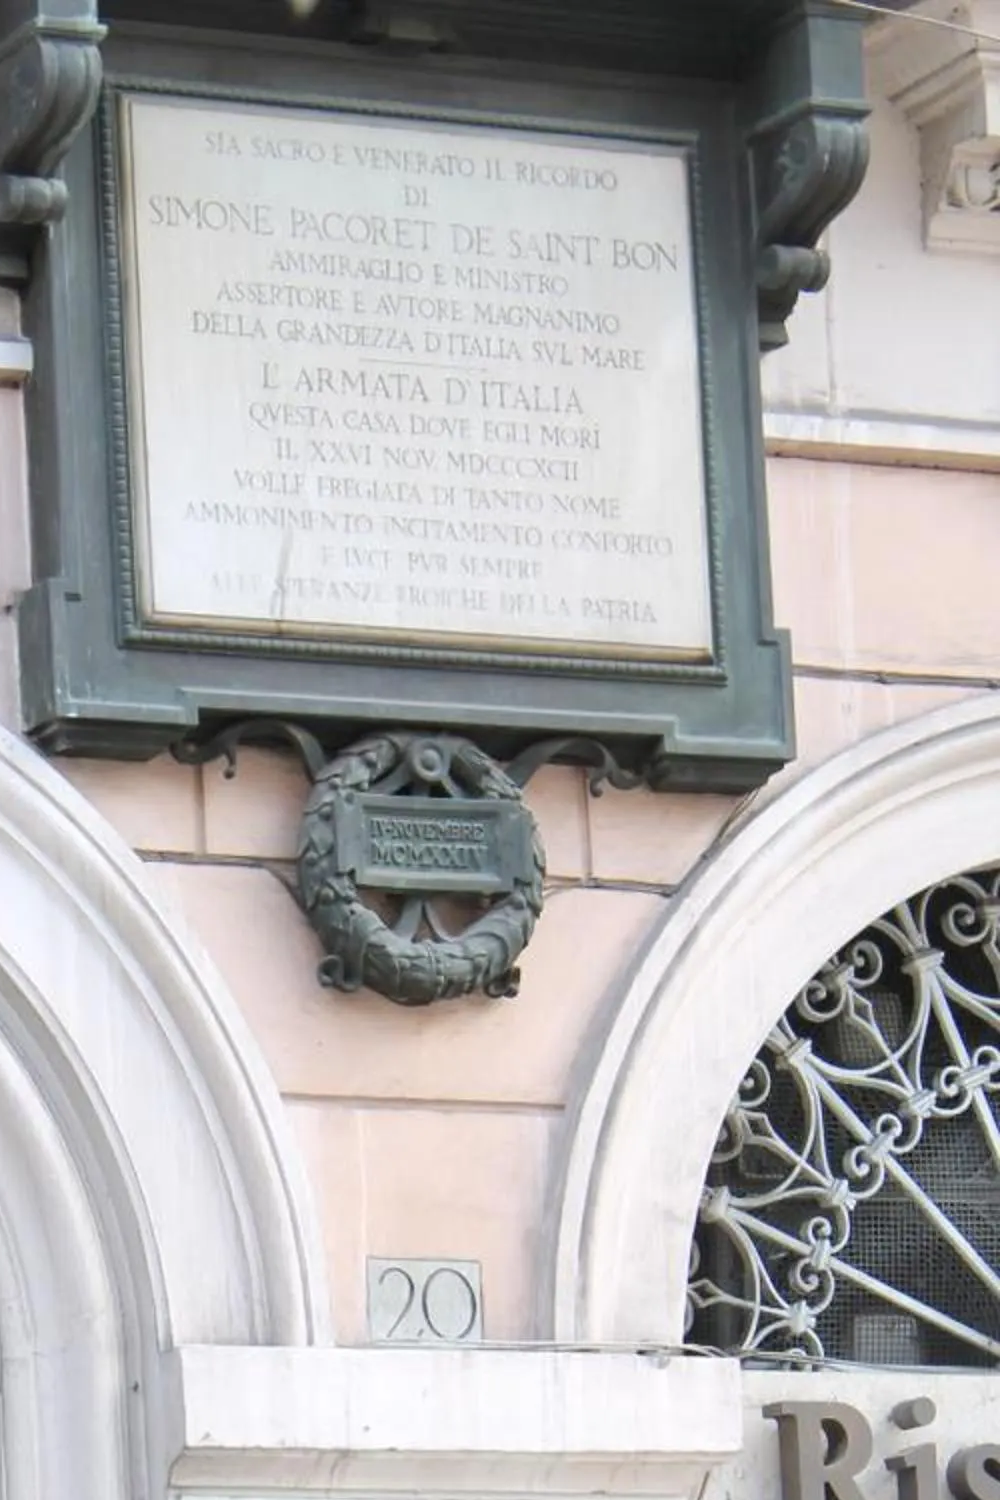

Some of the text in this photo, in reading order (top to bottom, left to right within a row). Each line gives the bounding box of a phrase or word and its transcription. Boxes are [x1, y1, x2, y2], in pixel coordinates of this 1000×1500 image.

[204, 131, 618, 192] SIA SACRO E VENERATO IL RICORDO
[404, 184, 430, 208] DI
[148, 194, 678, 273] SIMONE PACORET DE SAINT BON
[270, 249, 570, 297] AMMIRAGLIO E MINISTRO
[216, 281, 621, 335] ASSERTORE E AVTORE MAGNANIMO
[192, 309, 268, 340] DELLA
[276, 318, 414, 352] GRANDEZZA
[532, 340, 574, 367] SVL
[582, 345, 647, 372] MARE
[294, 366, 429, 403] ARMATA
[249, 401, 334, 432] QVESTA
[342, 409, 400, 435] CASA
[409, 413, 472, 440] DOVE
[483, 419, 531, 445] EGLI
[309, 439, 372, 467] XXVI
[447, 449, 580, 482] MDCCCXCII
[233, 467, 622, 521] VOLLE FREGIATA DI TANTO NOME
[183, 500, 675, 556] AMMONIMENTO INCITAMENTO CONFORTO
[459, 553, 544, 581] SEMPRE
[500, 591, 572, 618] DELLA
[581, 596, 658, 625] PATRIA
[378, 1266, 477, 1339] 20
